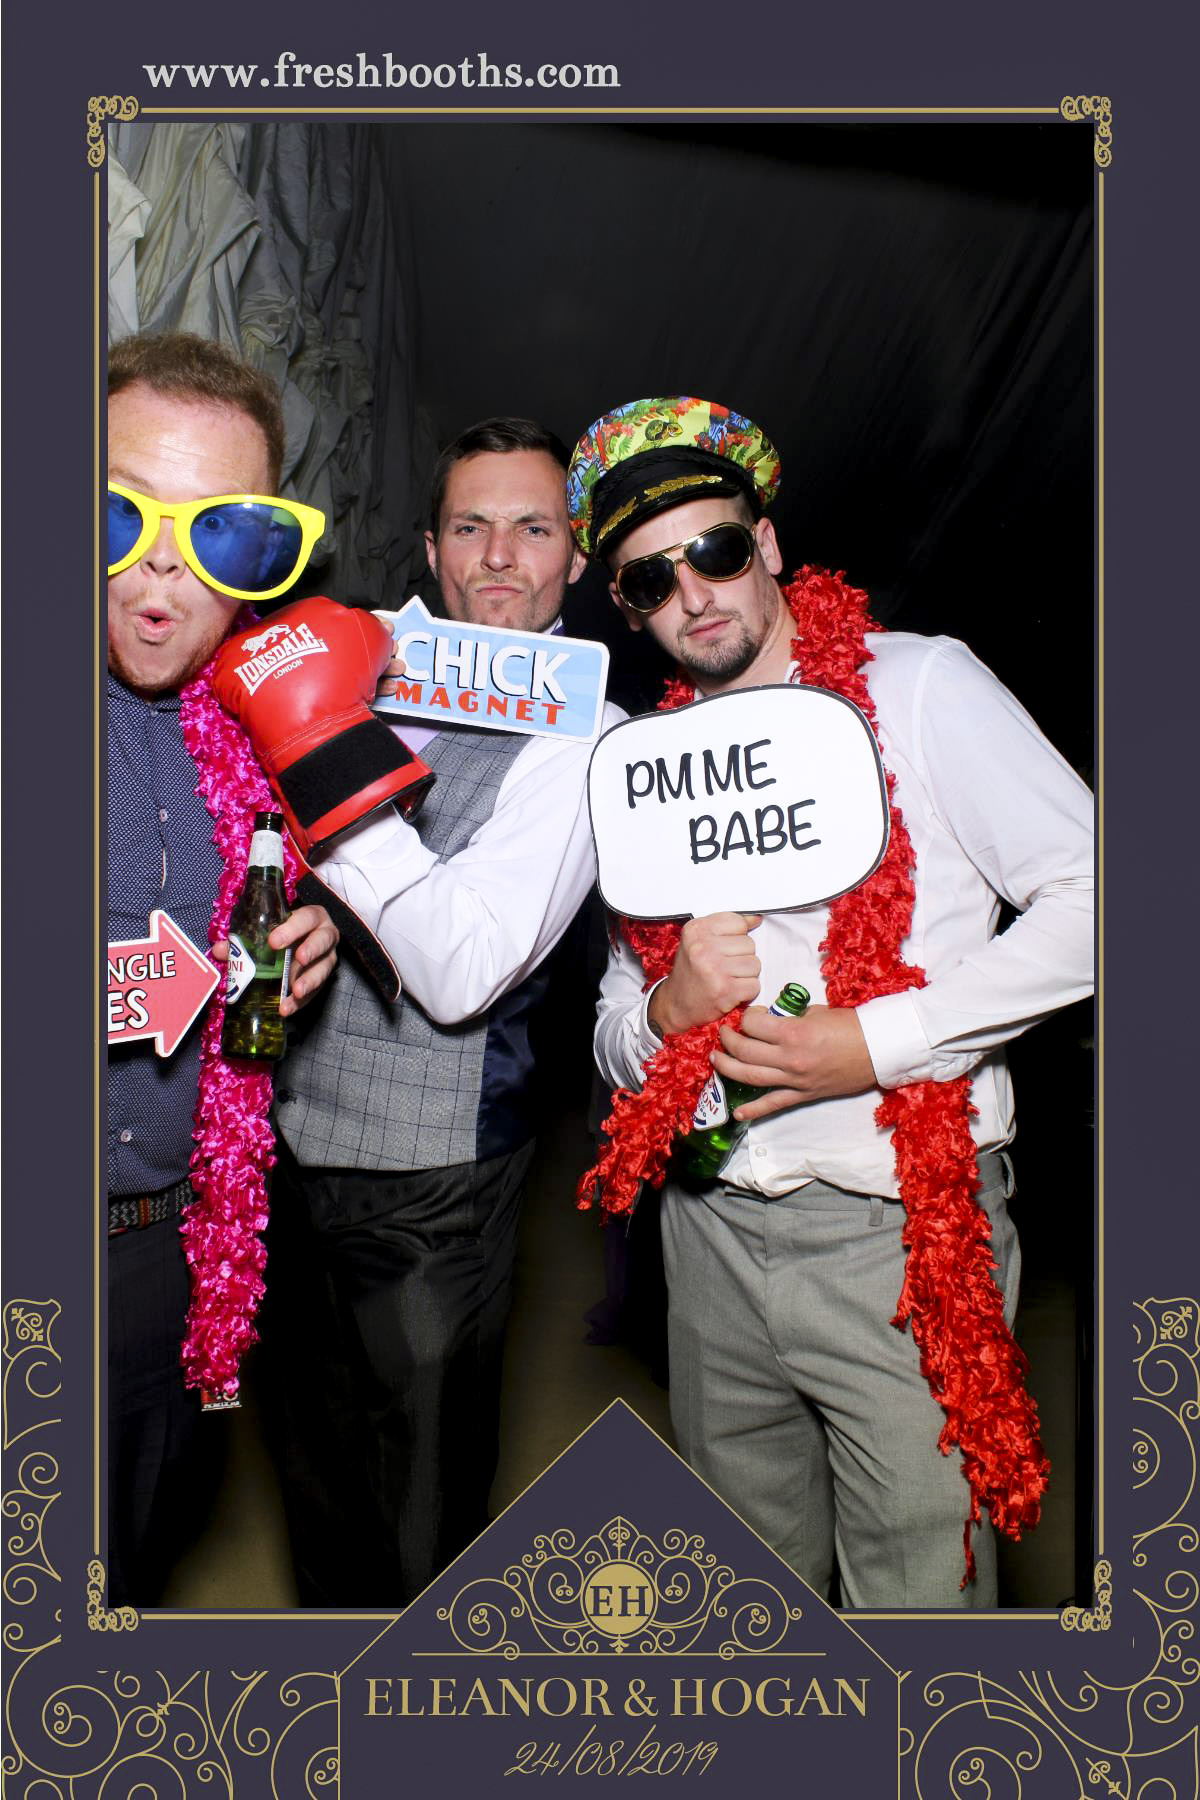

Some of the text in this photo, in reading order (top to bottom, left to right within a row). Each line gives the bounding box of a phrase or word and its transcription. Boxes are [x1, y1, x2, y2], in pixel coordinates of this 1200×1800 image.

[234, 622, 329, 696] LONSDALE
[273, 658, 304, 680] LONDON
[397, 631, 571, 704] CHICK
[395, 681, 566, 726] MAGNET
[625, 738, 777, 809] PM ME
[688, 798, 822, 865] BABE
